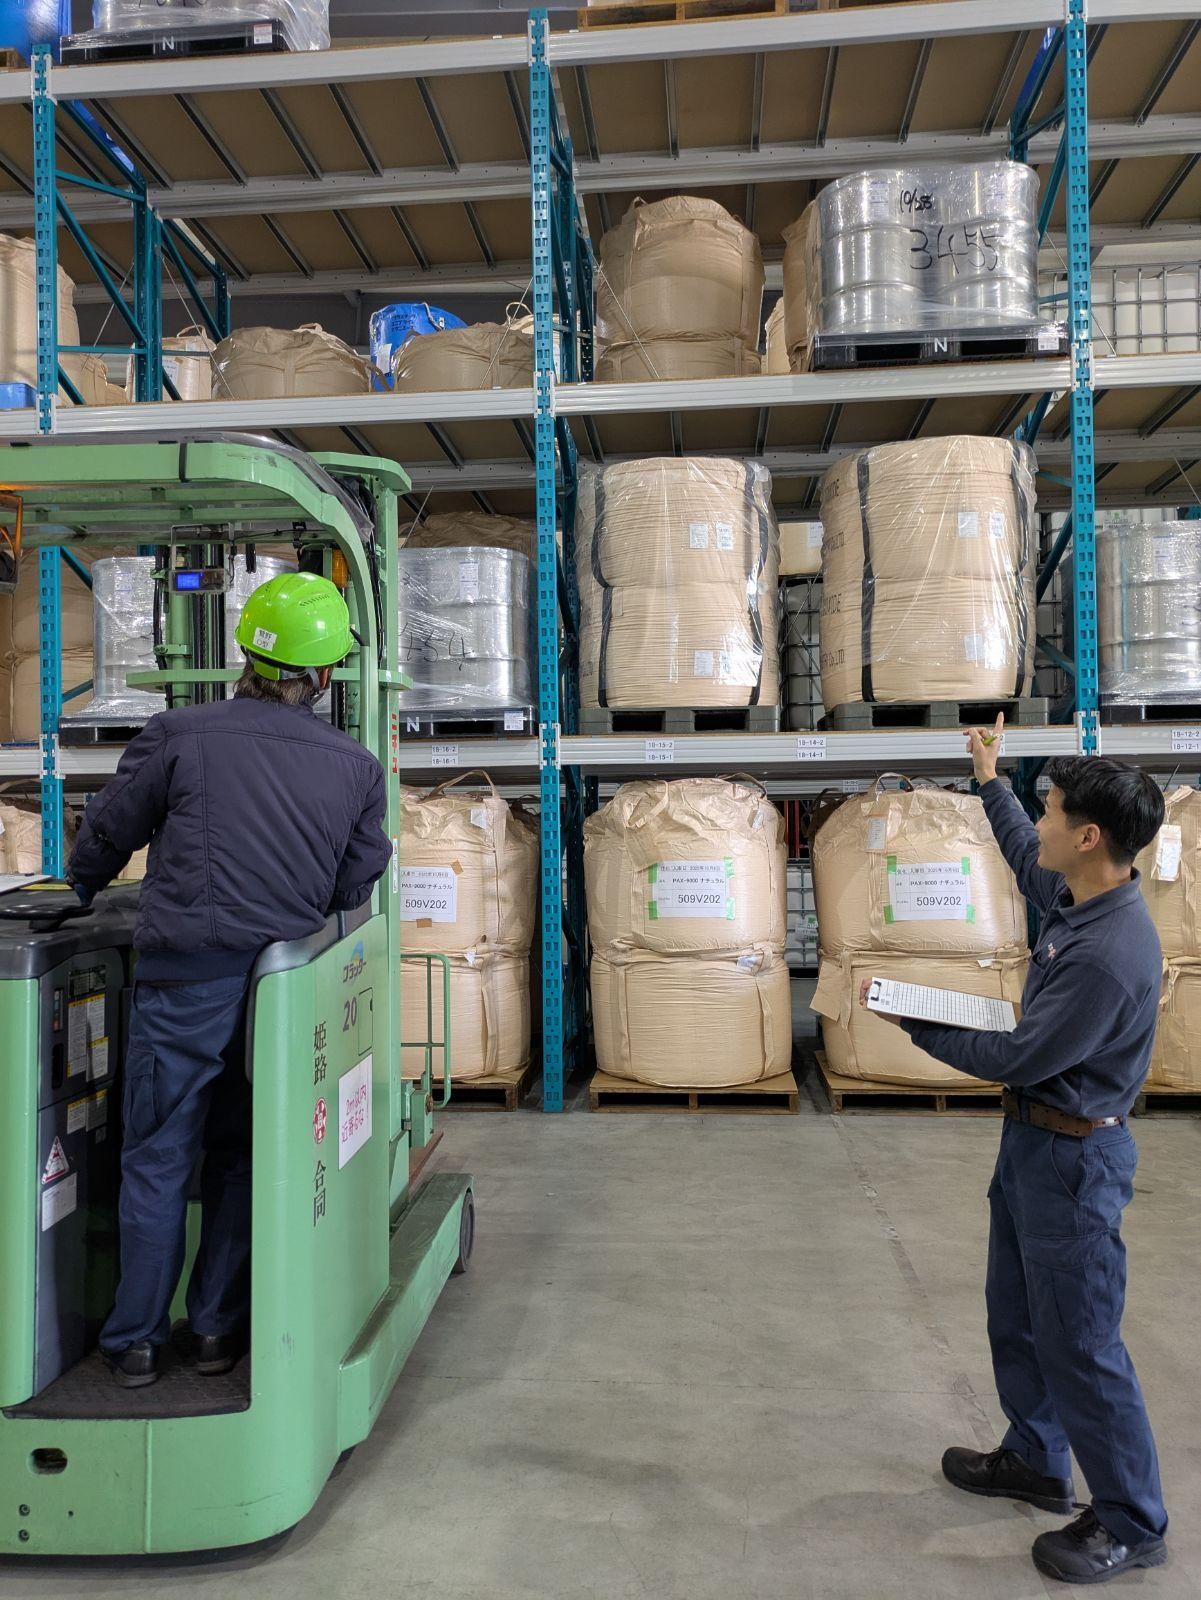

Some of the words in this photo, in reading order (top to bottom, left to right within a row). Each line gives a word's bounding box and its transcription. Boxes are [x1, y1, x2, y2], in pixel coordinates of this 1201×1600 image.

[162, 36, 175, 51] N
[910, 225, 1004, 274] 3455
[934, 337, 948, 352] N
[406, 716, 420, 733] N
[1172, 730, 1200, 738] 18-12-2
[405, 899, 447, 909] 509V202
[678, 894, 721, 904] 509V202
[916, 896, 962, 906] 509V202
[342, 996, 357, 1033] 20
[313, 1020, 327, 1086] 姫路
[313, 1159, 327, 1228] 合同
